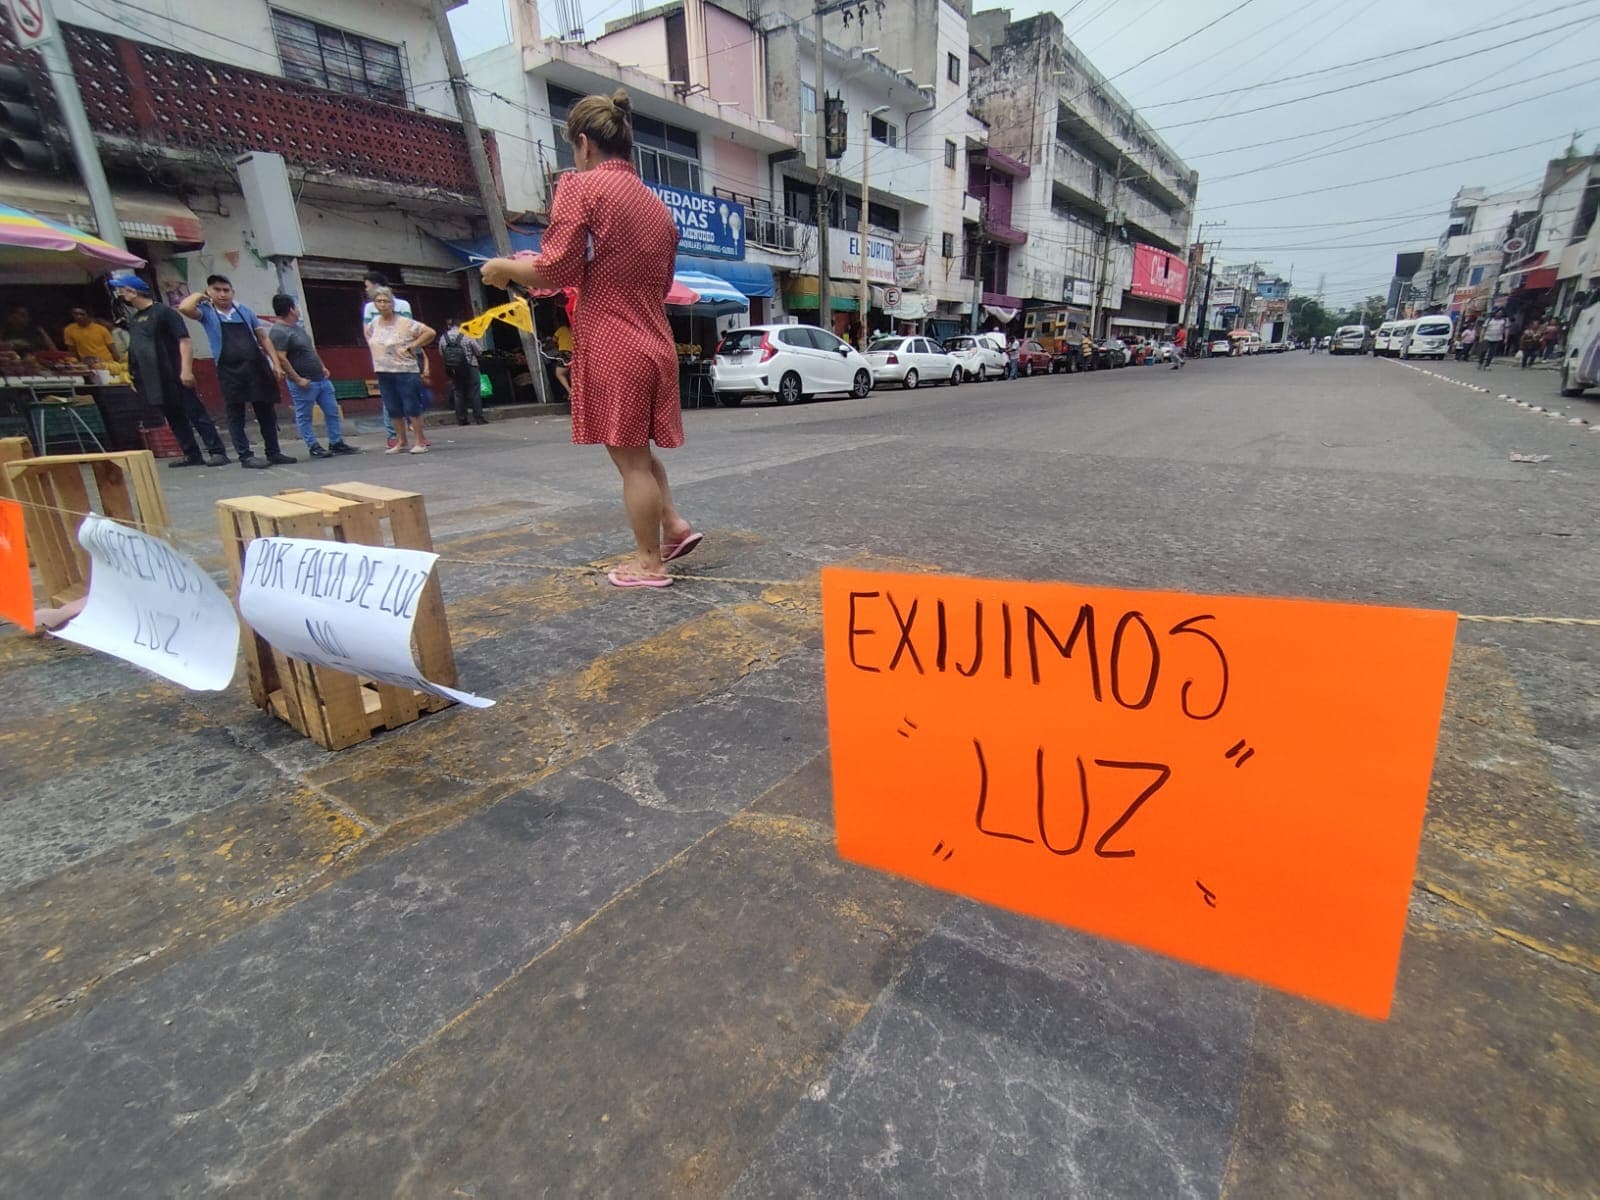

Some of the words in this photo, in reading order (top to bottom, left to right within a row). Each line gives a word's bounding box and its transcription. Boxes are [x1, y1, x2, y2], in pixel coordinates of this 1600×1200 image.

[647, 185, 716, 214] VEDADES
[849, 237, 860, 256] EL
[888, 291, 897, 303] E
[250, 539, 293, 589] POR
[295, 547, 345, 600] FALTA
[345, 555, 382, 609] DE
[849, 591, 1230, 721] EXIJIMOS
